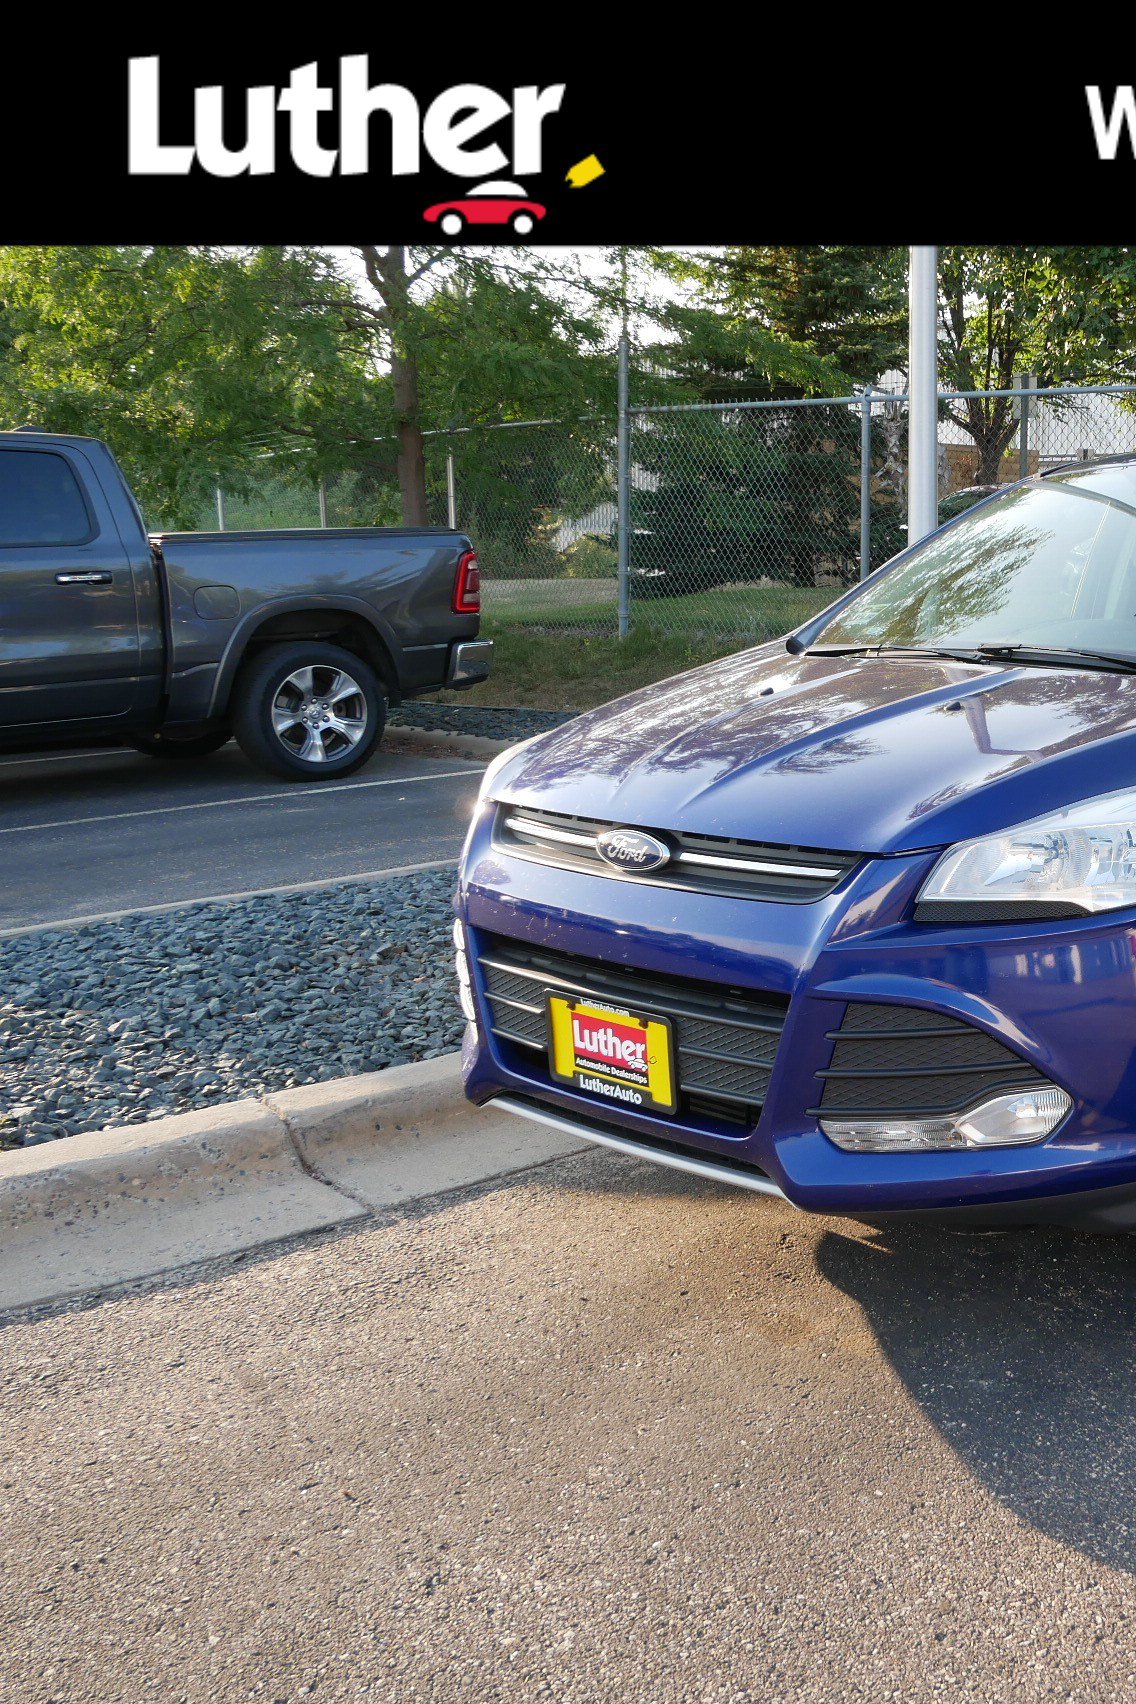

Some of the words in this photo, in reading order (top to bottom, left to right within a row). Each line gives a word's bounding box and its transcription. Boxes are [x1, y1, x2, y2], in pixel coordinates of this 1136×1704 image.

[607, 835, 649, 862] Ford
[573, 1019, 646, 1062] Luther
[576, 1057, 611, 1074] Automobile
[611, 1066, 648, 1084] Dealerships
[579, 1074, 643, 1105] LutherAuto
